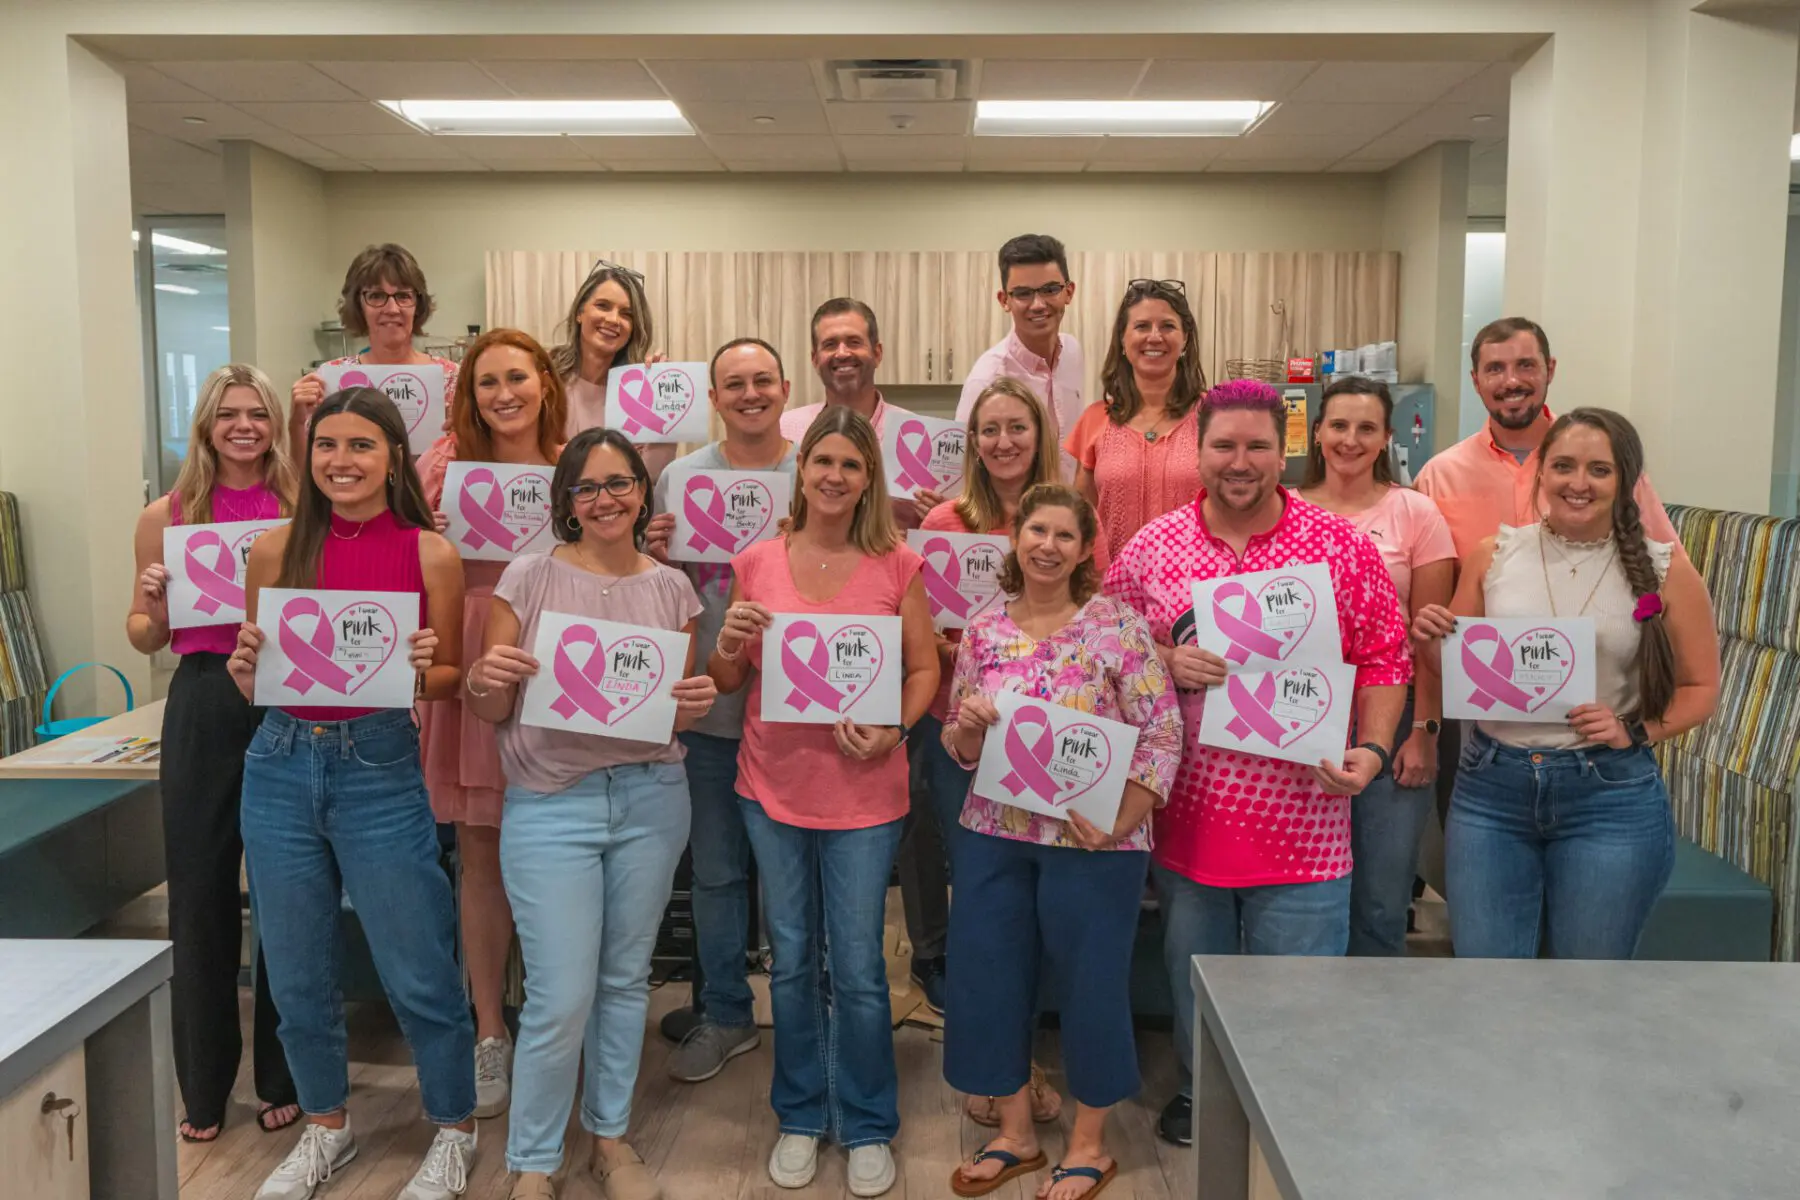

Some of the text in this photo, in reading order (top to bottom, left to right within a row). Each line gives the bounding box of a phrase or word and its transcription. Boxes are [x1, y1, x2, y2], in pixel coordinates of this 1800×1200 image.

[386, 383, 417, 400] pink
[658, 378, 685, 397] pink
[937, 439, 965, 456] pink
[511, 485, 544, 507] pink
[731, 490, 762, 511] pink
[966, 554, 997, 575] pink
[1266, 587, 1302, 613] pink
[342, 615, 383, 641] pink
[350, 637, 361, 645] for
[836, 636, 870, 662] pink
[613, 649, 652, 672] pink
[842, 658, 852, 666] for
[1520, 640, 1561, 666] pink
[619, 669, 630, 678] for
[1529, 661, 1541, 670] for
[605, 680, 642, 692] LINDA
[1283, 677, 1320, 698] pink
[1061, 736, 1098, 758] pink
[1066, 755, 1076, 764] for
